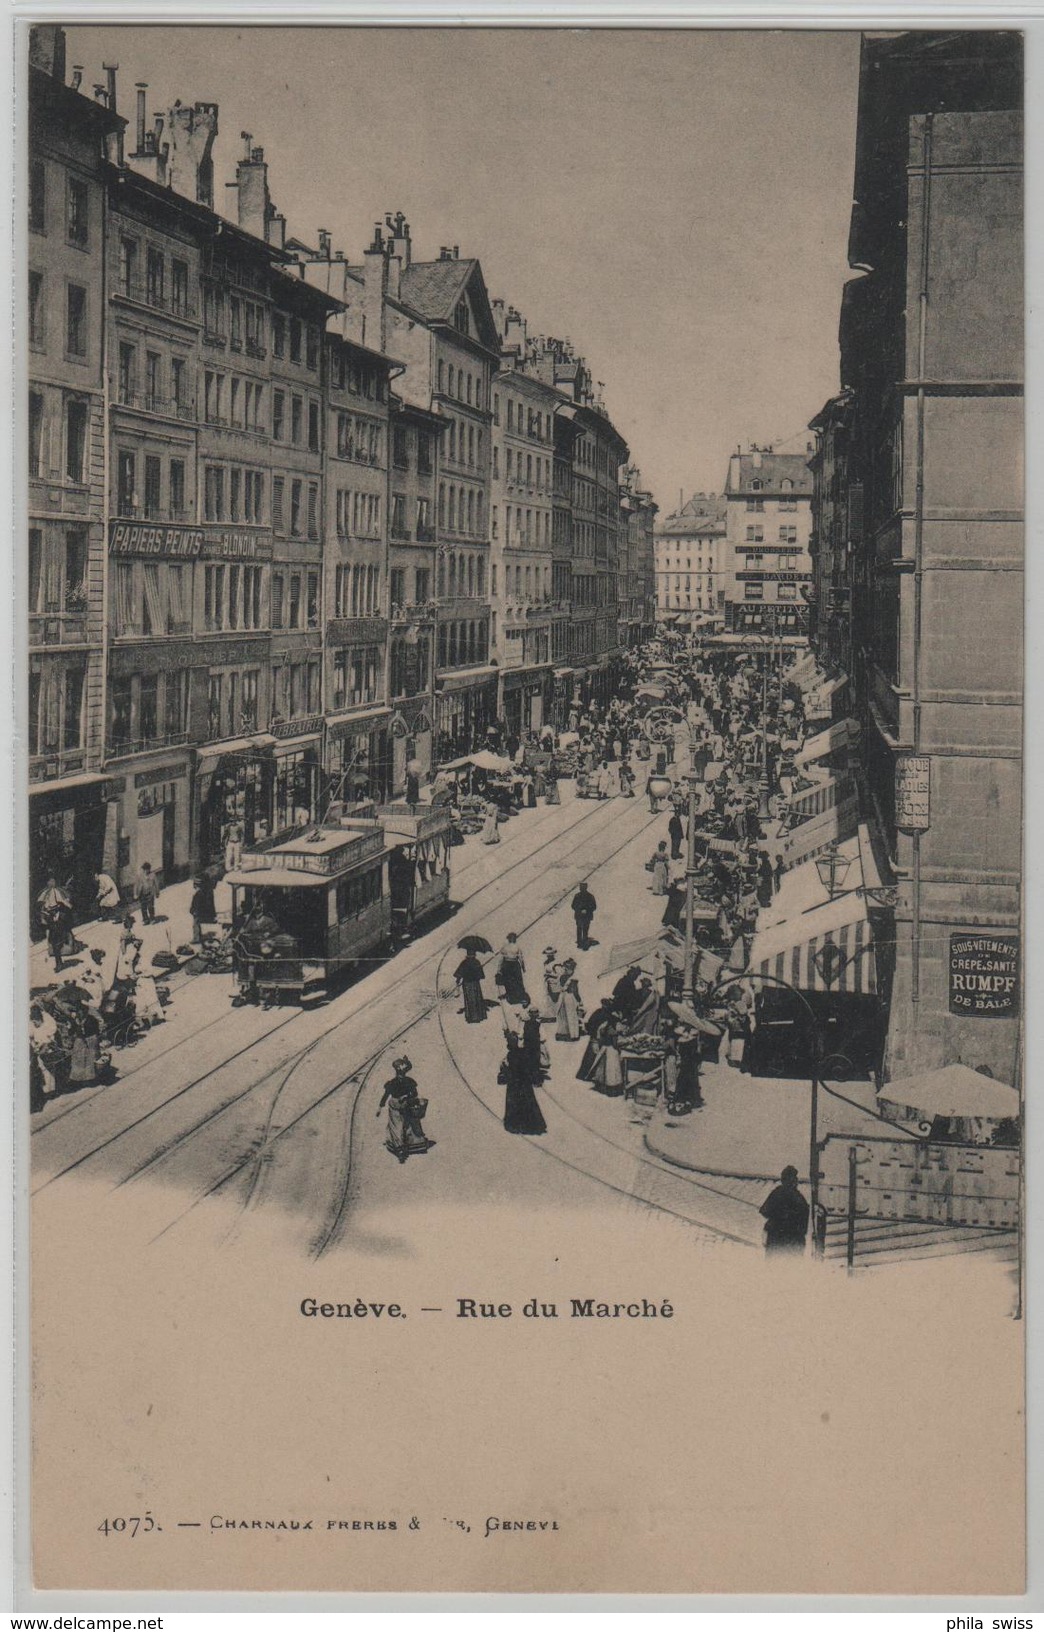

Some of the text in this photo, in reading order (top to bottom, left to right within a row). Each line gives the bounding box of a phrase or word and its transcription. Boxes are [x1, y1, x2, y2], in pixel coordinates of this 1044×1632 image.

[112, 526, 163, 553] PAPIERS
[165, 530, 203, 554] PEINTS
[739, 605, 756, 613] AU
[760, 605, 795, 613] PETIT
[952, 974, 1016, 993] RUMPF
[953, 994, 972, 1007] DE
[300, 1297, 407, 1320] Genève.
[456, 1299, 513, 1319] Rue
[522, 1299, 559, 1319] du
[570, 1298, 674, 1319] Marché
[408, 1516, 421, 1530] &
